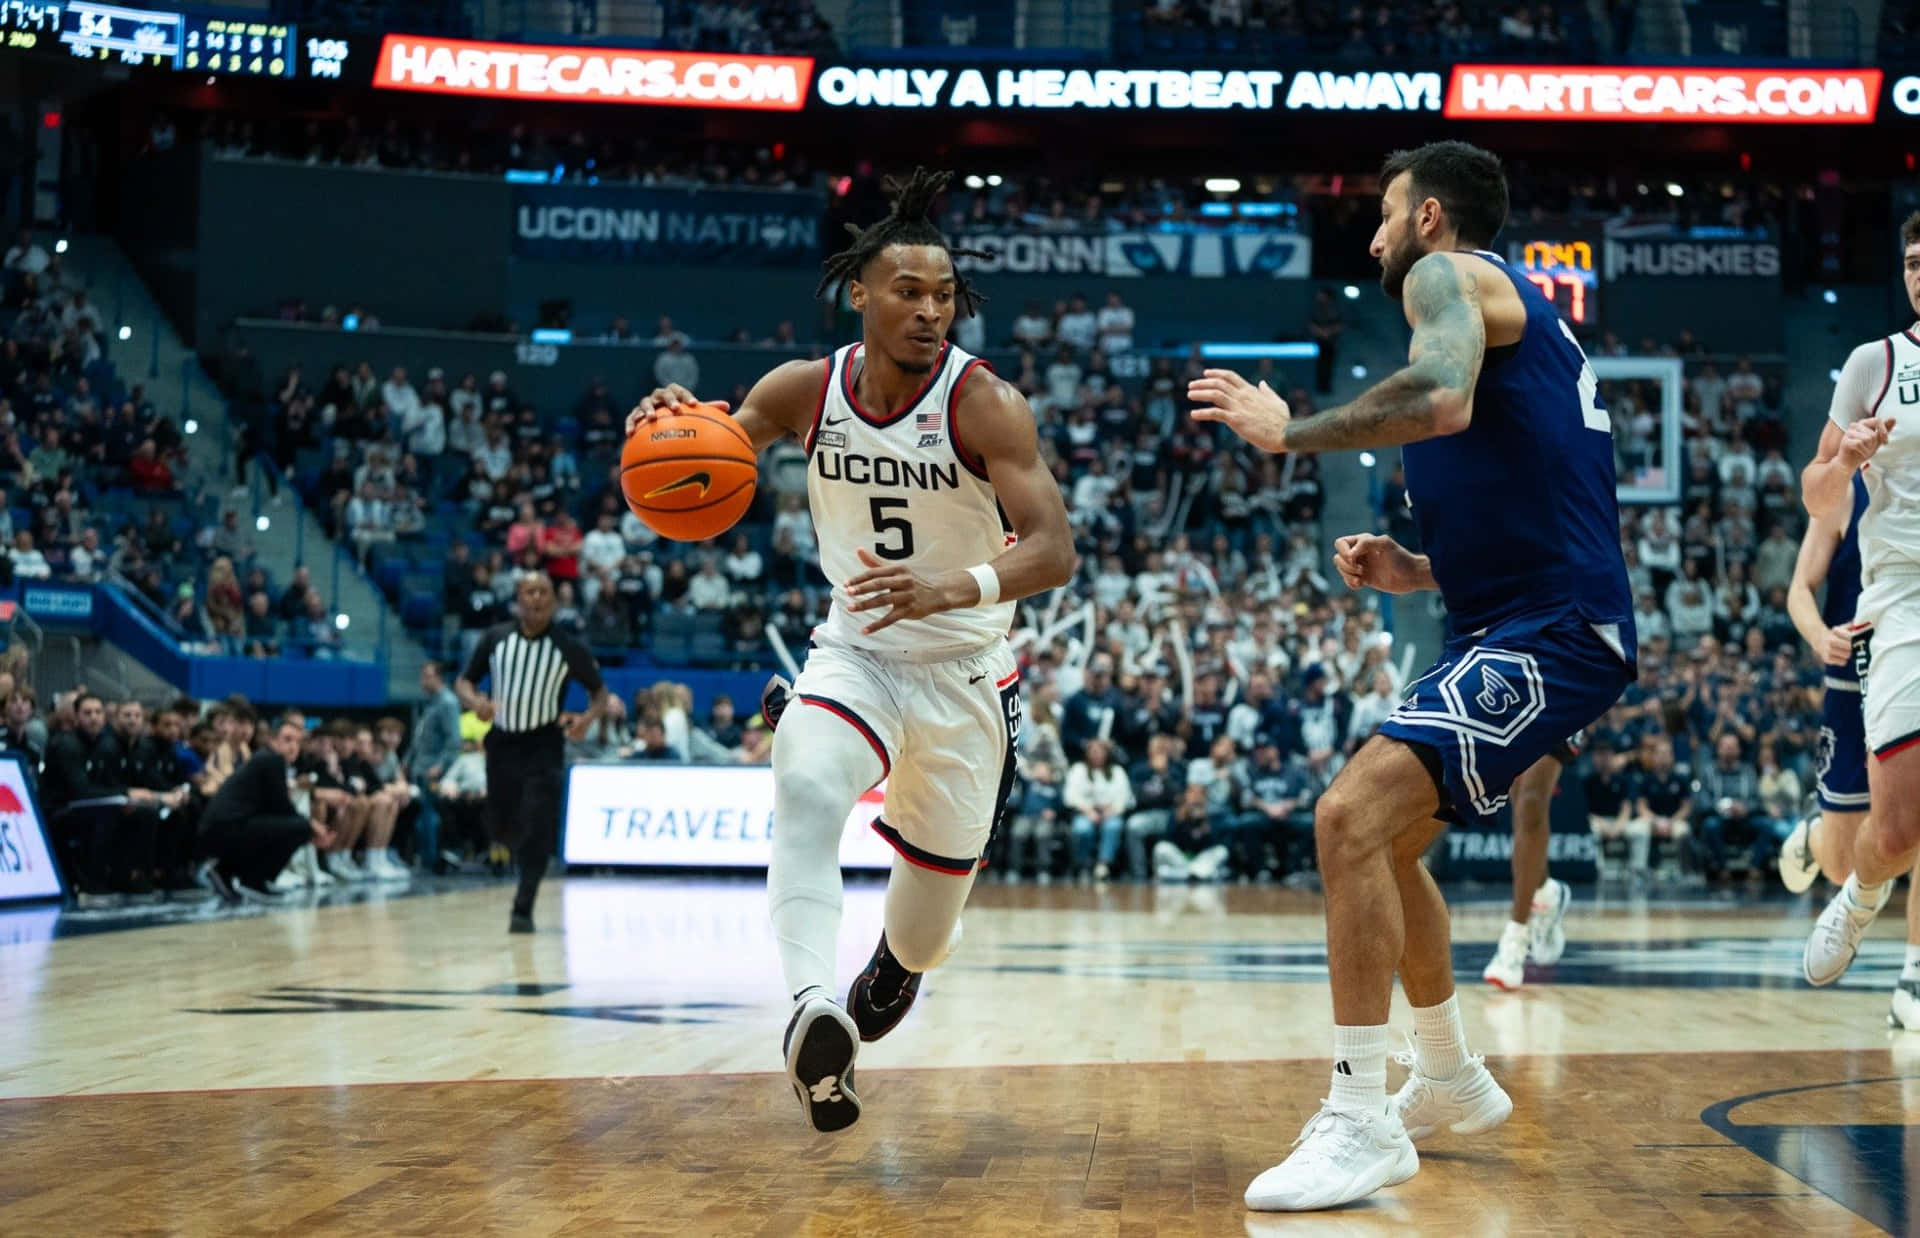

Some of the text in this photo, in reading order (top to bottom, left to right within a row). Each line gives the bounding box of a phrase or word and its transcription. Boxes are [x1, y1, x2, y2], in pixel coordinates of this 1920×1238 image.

[79, 10, 112, 39] 54
[390, 43, 799, 103] HARTECARS.COM
[818, 67, 1442, 110] ONLY A HEARTBEAT AWAY!
[1461, 73, 1868, 115] HARTECARS.COM
[518, 205, 659, 241] UCONN
[1618, 243, 1780, 276] HUSKIES
[816, 451, 960, 491] UCONN
[869, 497, 914, 560] 5
[1447, 832, 1597, 861] TRAVERS
